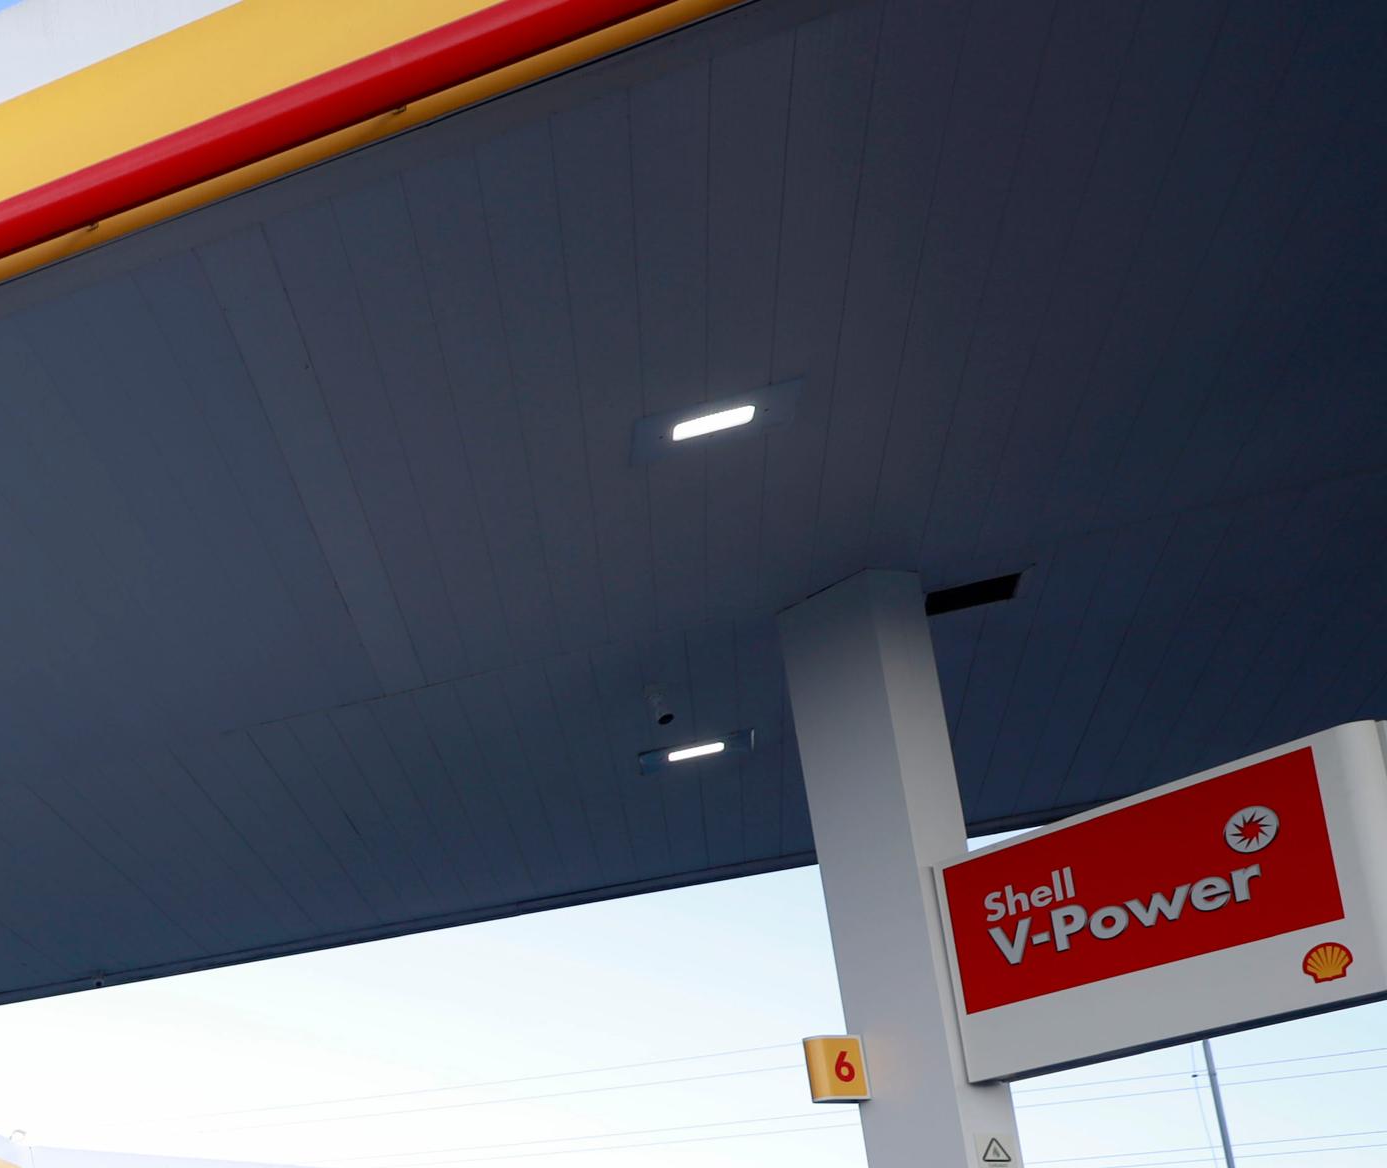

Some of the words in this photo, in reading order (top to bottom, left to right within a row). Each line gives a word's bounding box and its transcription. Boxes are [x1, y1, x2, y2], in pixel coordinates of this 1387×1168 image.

[984, 867, 1076, 922] Shell
[988, 864, 1261, 964] V-Power
[833, 1051, 856, 1082] 6
